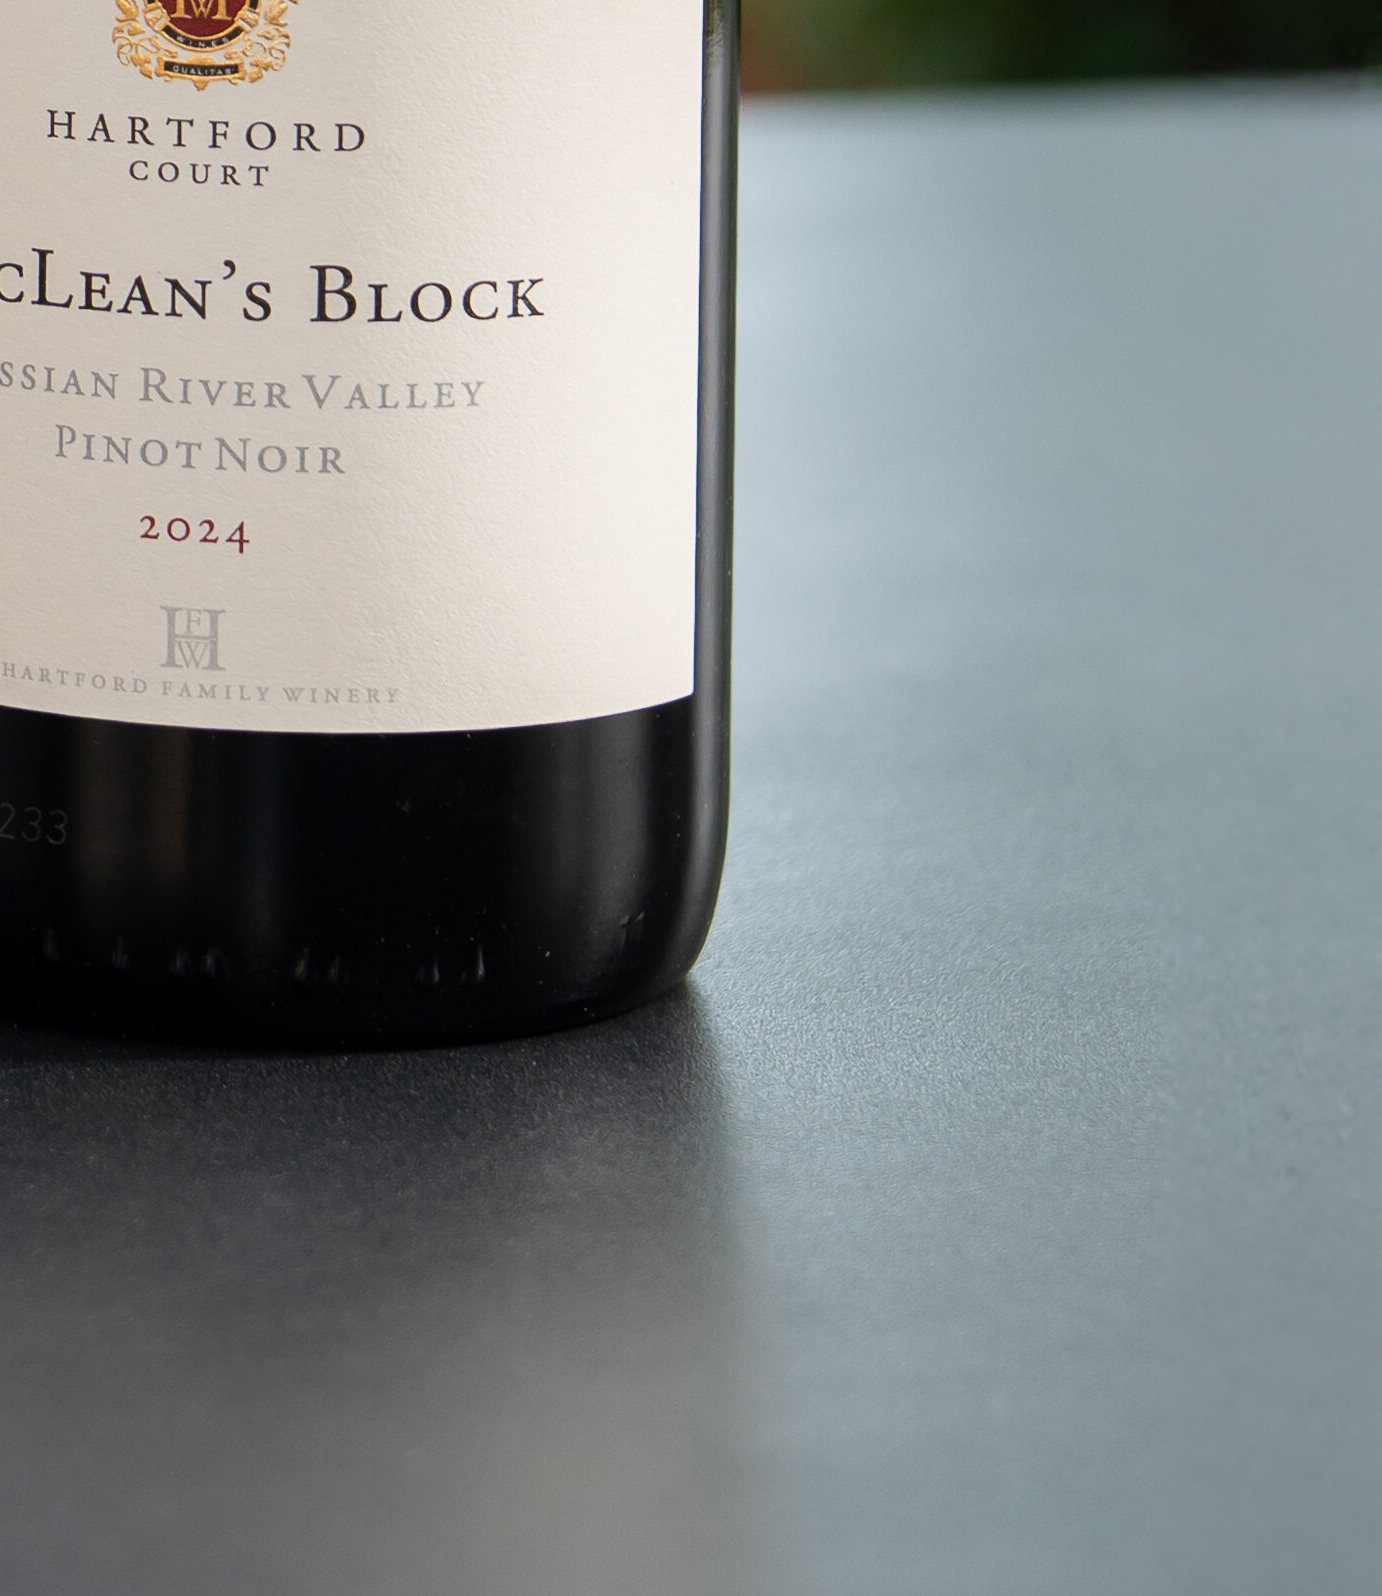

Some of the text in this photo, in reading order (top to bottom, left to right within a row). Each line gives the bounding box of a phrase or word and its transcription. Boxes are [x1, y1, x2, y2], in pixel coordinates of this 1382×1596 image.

[175, 35, 231, 49] WINES
[47, 109, 366, 152] HARTFORD
[128, 160, 270, 187] COURT
[140, 515, 250, 555] 2024
[1, 660, 399, 705] HARTFORD FAMILY WINERY
